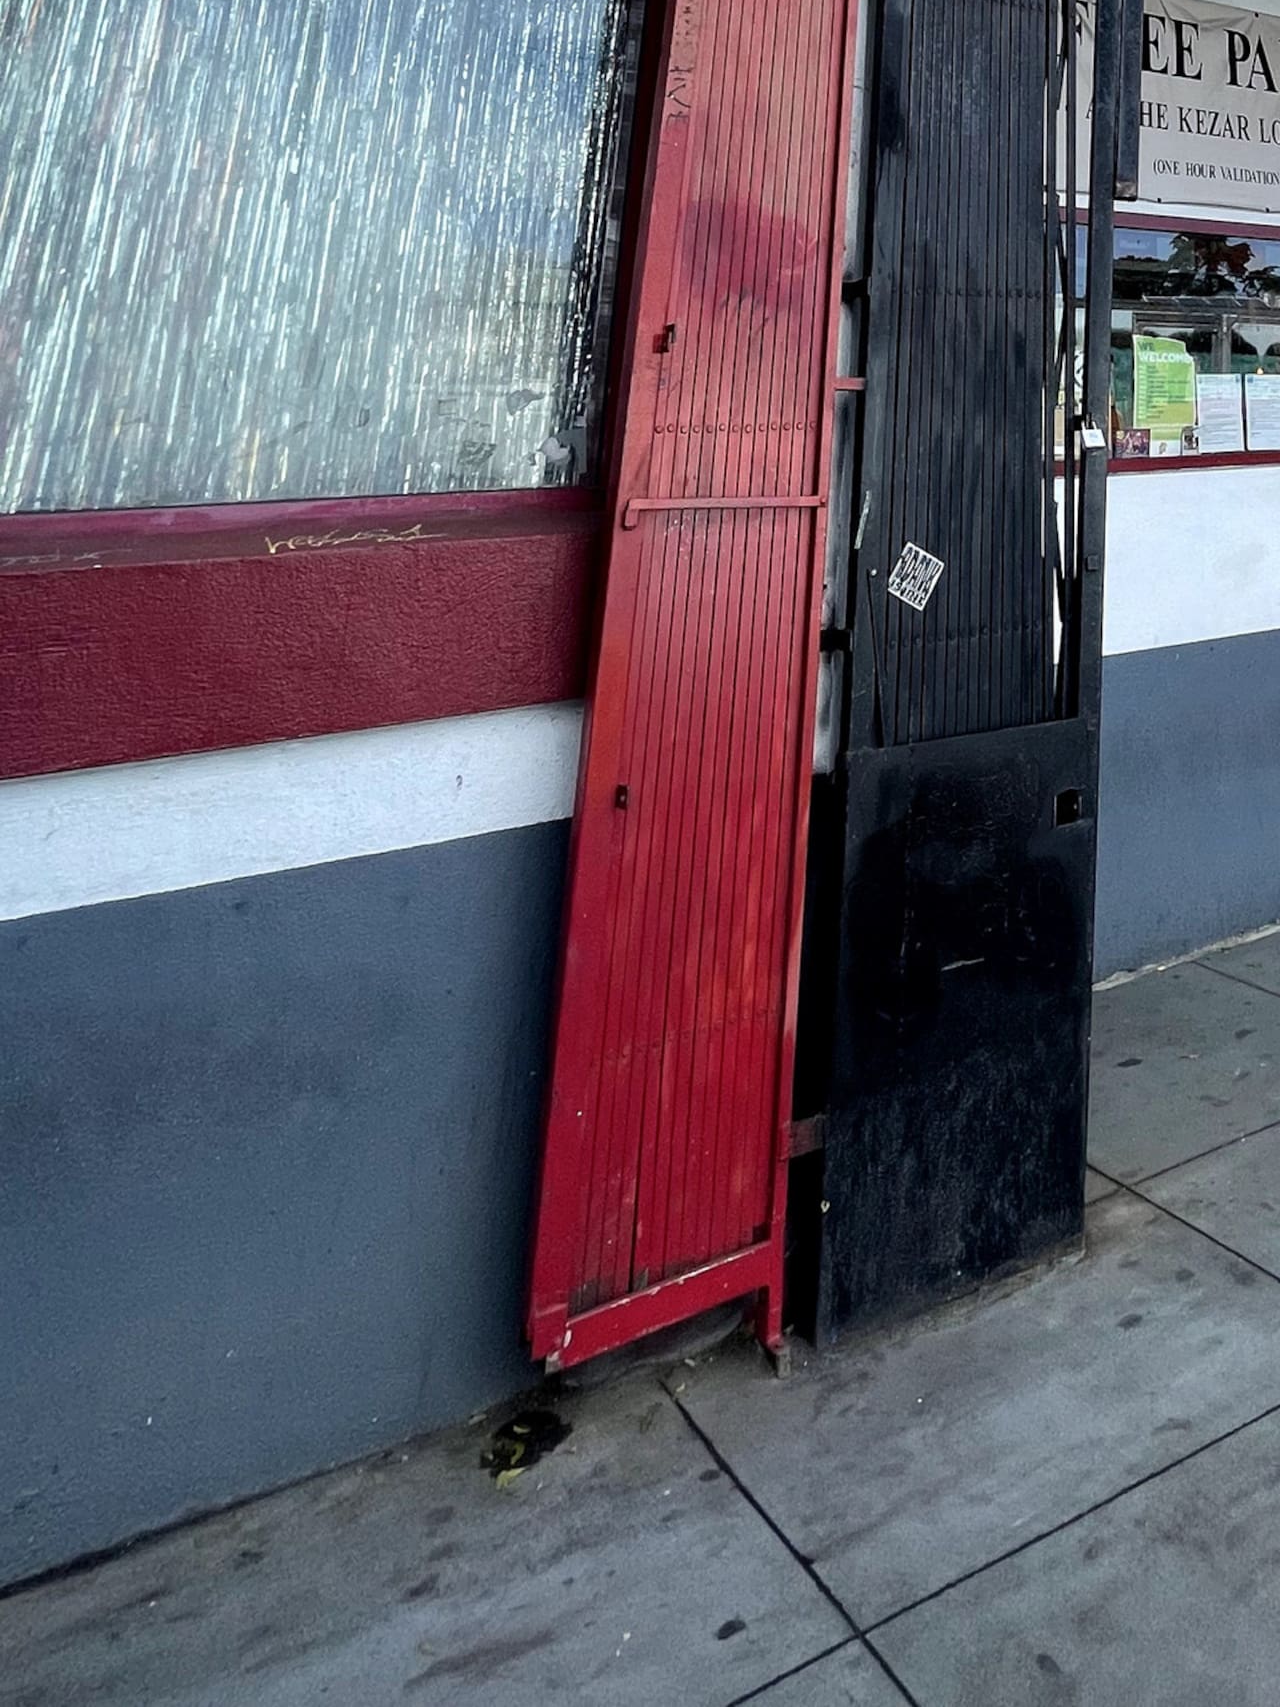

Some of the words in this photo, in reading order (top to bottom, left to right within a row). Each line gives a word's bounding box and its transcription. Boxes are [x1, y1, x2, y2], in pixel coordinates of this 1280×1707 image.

[1139, 101, 1169, 130] HE
[1178, 106, 1251, 142] KEZAR
[1153, 158, 1180, 176] (ONE
[1186, 162, 1217, 179] HOUR
[1220, 166, 1280, 186] VALIDATION
